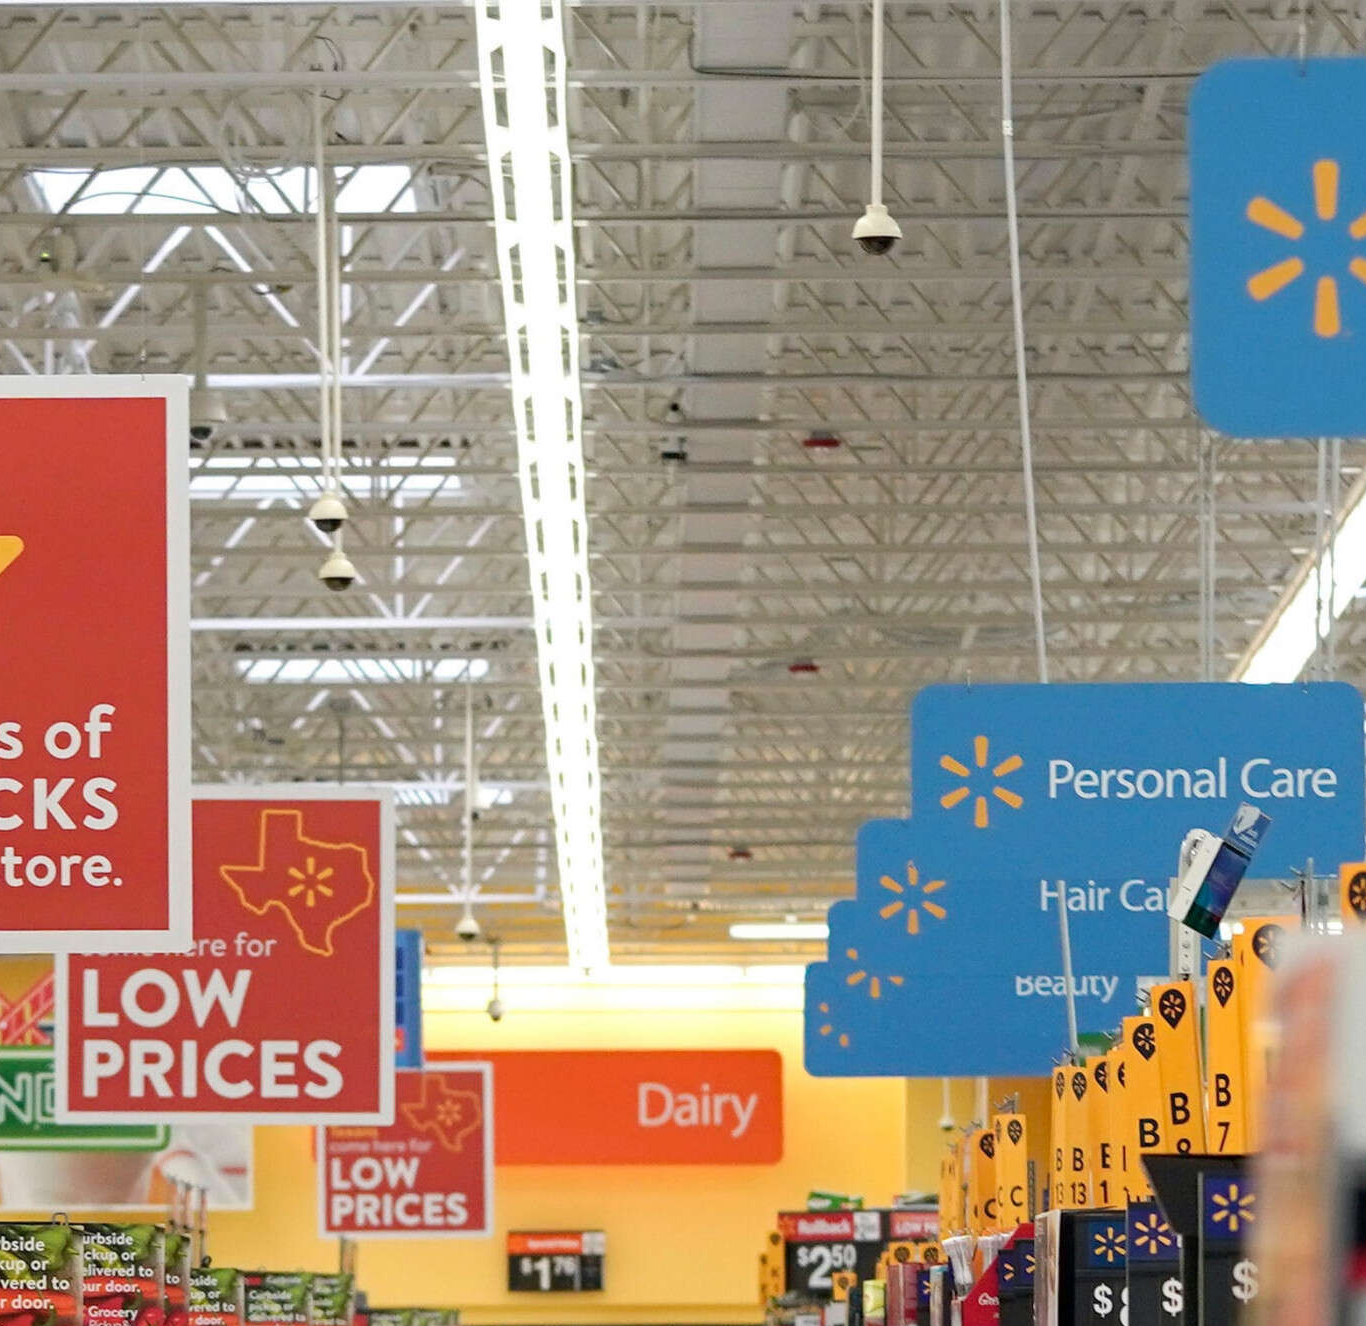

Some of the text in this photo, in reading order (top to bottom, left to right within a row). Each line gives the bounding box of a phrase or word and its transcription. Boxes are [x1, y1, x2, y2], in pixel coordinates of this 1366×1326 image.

[44, 703, 116, 760] of
[1048, 757, 1338, 800] Personal Care
[1040, 879, 1111, 912] Hair
[234, 931, 277, 957] for
[82, 968, 253, 1029] LOW
[82, 1038, 344, 1099] PRICES
[1215, 1073, 1232, 1107] B
[638, 1083, 758, 1137] Dairy
[1170, 1092, 1191, 1125] B
[1138, 1118, 1161, 1148] B
[1217, 1121, 1230, 1153] 7
[331, 1157, 420, 1190] LOW
[331, 1193, 468, 1226] PRICES
[1070, 1182, 1088, 1205] 13
[30, 1258, 49, 1272] or
[121, 1250, 137, 1262] or
[138, 1264, 154, 1278] to
[797, 1244, 858, 1289] $250
[51, 1276, 71, 1291] to
[105, 1279, 142, 1293] door.
[11, 1294, 55, 1310] door.
[88, 1305, 139, 1321] Grocery
